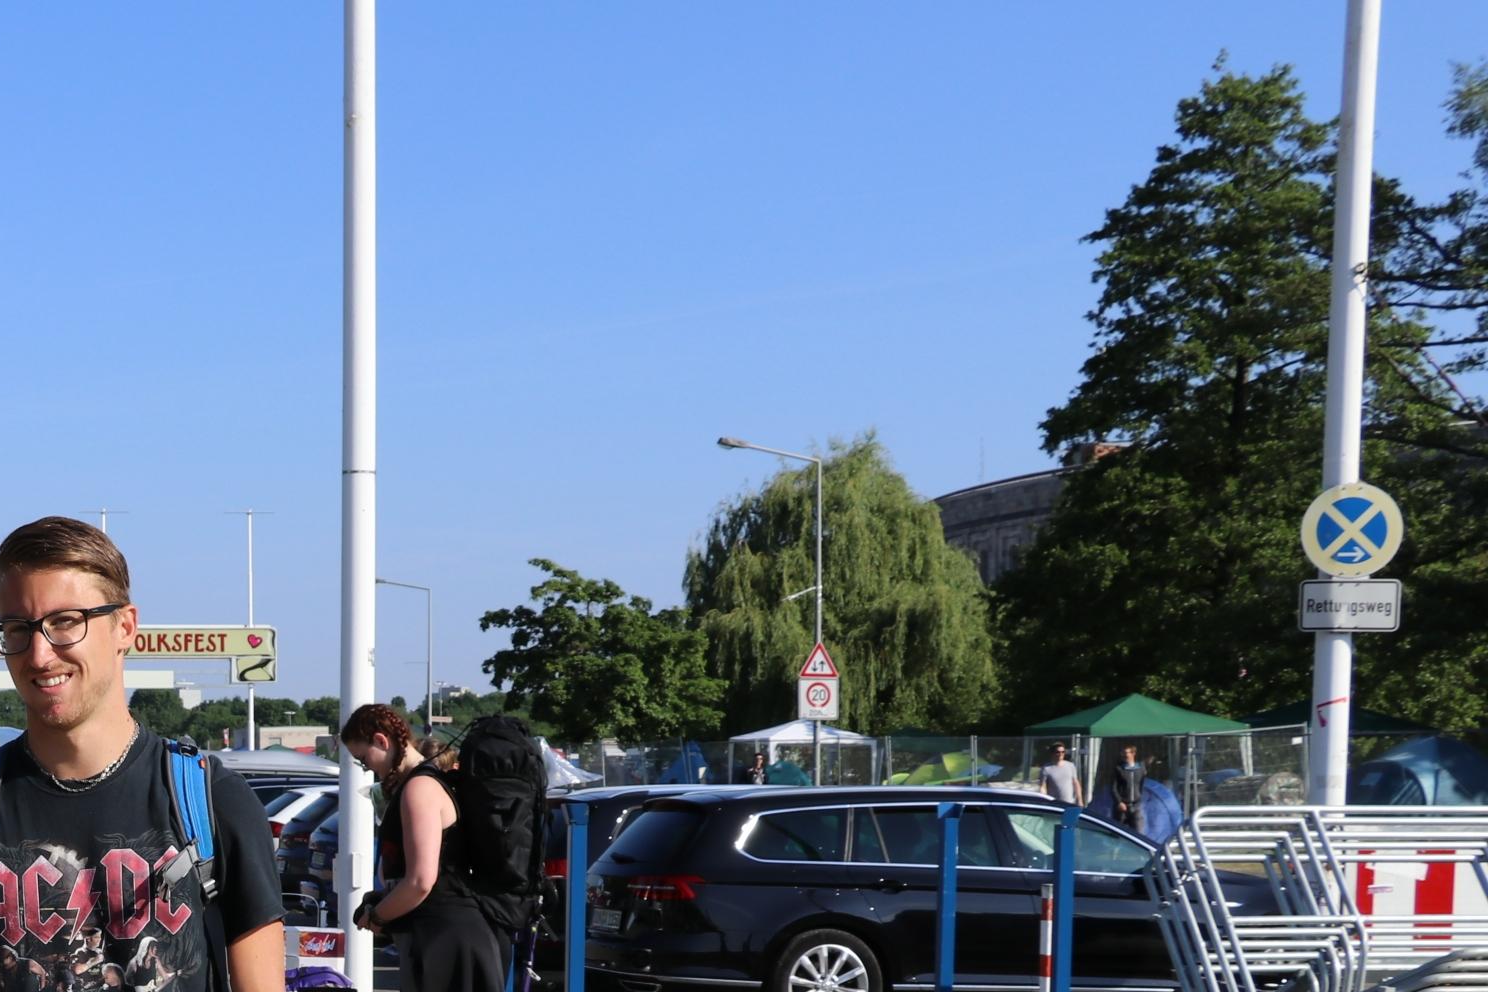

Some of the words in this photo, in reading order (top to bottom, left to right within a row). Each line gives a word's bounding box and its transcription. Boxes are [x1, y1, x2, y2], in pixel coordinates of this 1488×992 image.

[1307, 599, 1392, 616] Rettugsweg
[134, 633, 228, 653] OLKSFEST
[812, 689, 826, 701] 20
